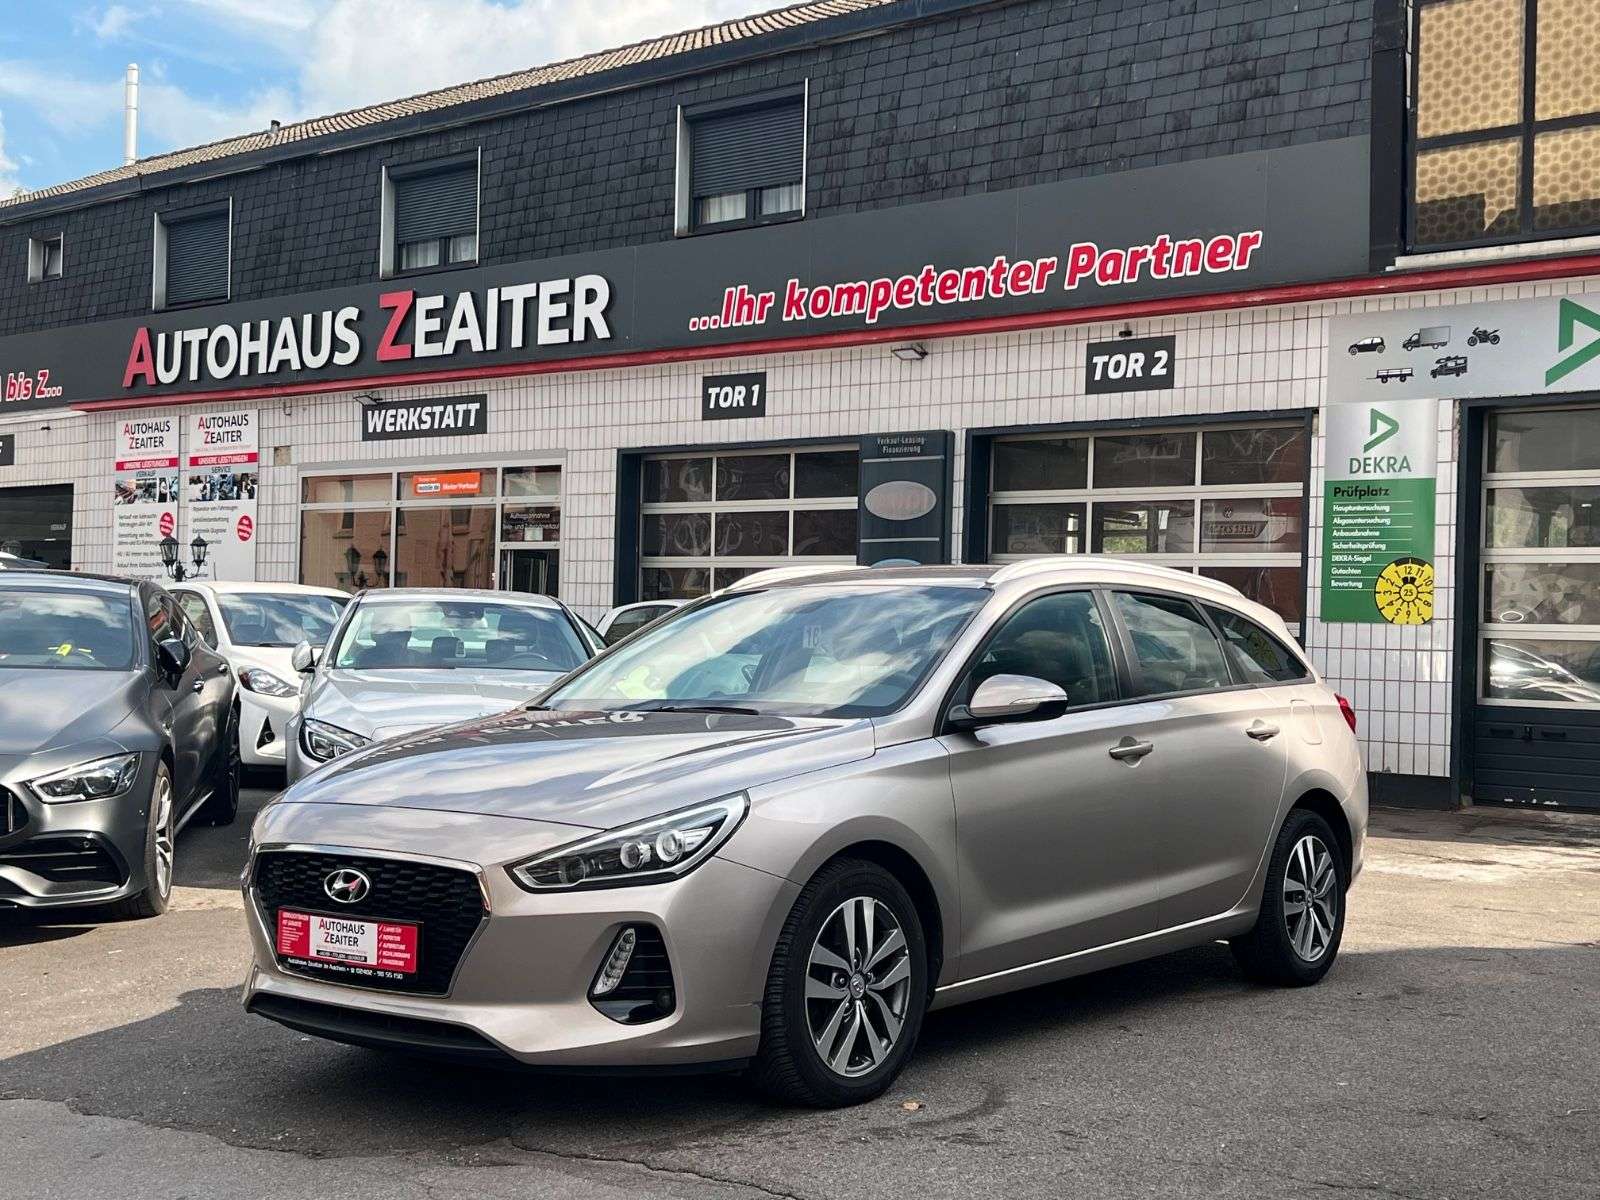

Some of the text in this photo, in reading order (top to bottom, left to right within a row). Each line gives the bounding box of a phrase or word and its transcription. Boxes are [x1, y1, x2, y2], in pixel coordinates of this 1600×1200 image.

[689, 230, 1263, 330] ...Ihr kompetenter Partner
[122, 274, 612, 388] AUTOHAUS ZEAITER
[1092, 349, 1168, 382] TOR 2
[6, 372, 32, 401] bis
[708, 383, 760, 409] TOR 1
[198, 414, 249, 429] AUTOHAUS
[367, 402, 480, 433] WERKSTATT
[124, 420, 171, 435] AUTOHAUS
[129, 436, 164, 449] ZEAITER
[204, 429, 242, 444] ZEAITER
[882, 445, 921, 454] Finanzierung
[1349, 455, 1412, 475] DEKRA
[1333, 485, 1390, 500] Prüfplatz
[1332, 503, 1390, 513] Hauptuntersuchung
[1332, 516, 1391, 526] Abgasuntersuchung
[1332, 529, 1380, 537] Anbauabnahme
[1332, 541, 1387, 551] Sicherheitsprüfung
[1331, 554, 1372, 564] DEKRA-Siegel
[1331, 567, 1362, 575] Gutachten
[1404, 565, 1413, 576] 12
[1330, 580, 1363, 588] Bewertung
[1403, 588, 1414, 597] 25
[319, 918, 365, 935] AUTOHAUS
[324, 931, 359, 948] ZEAITER
